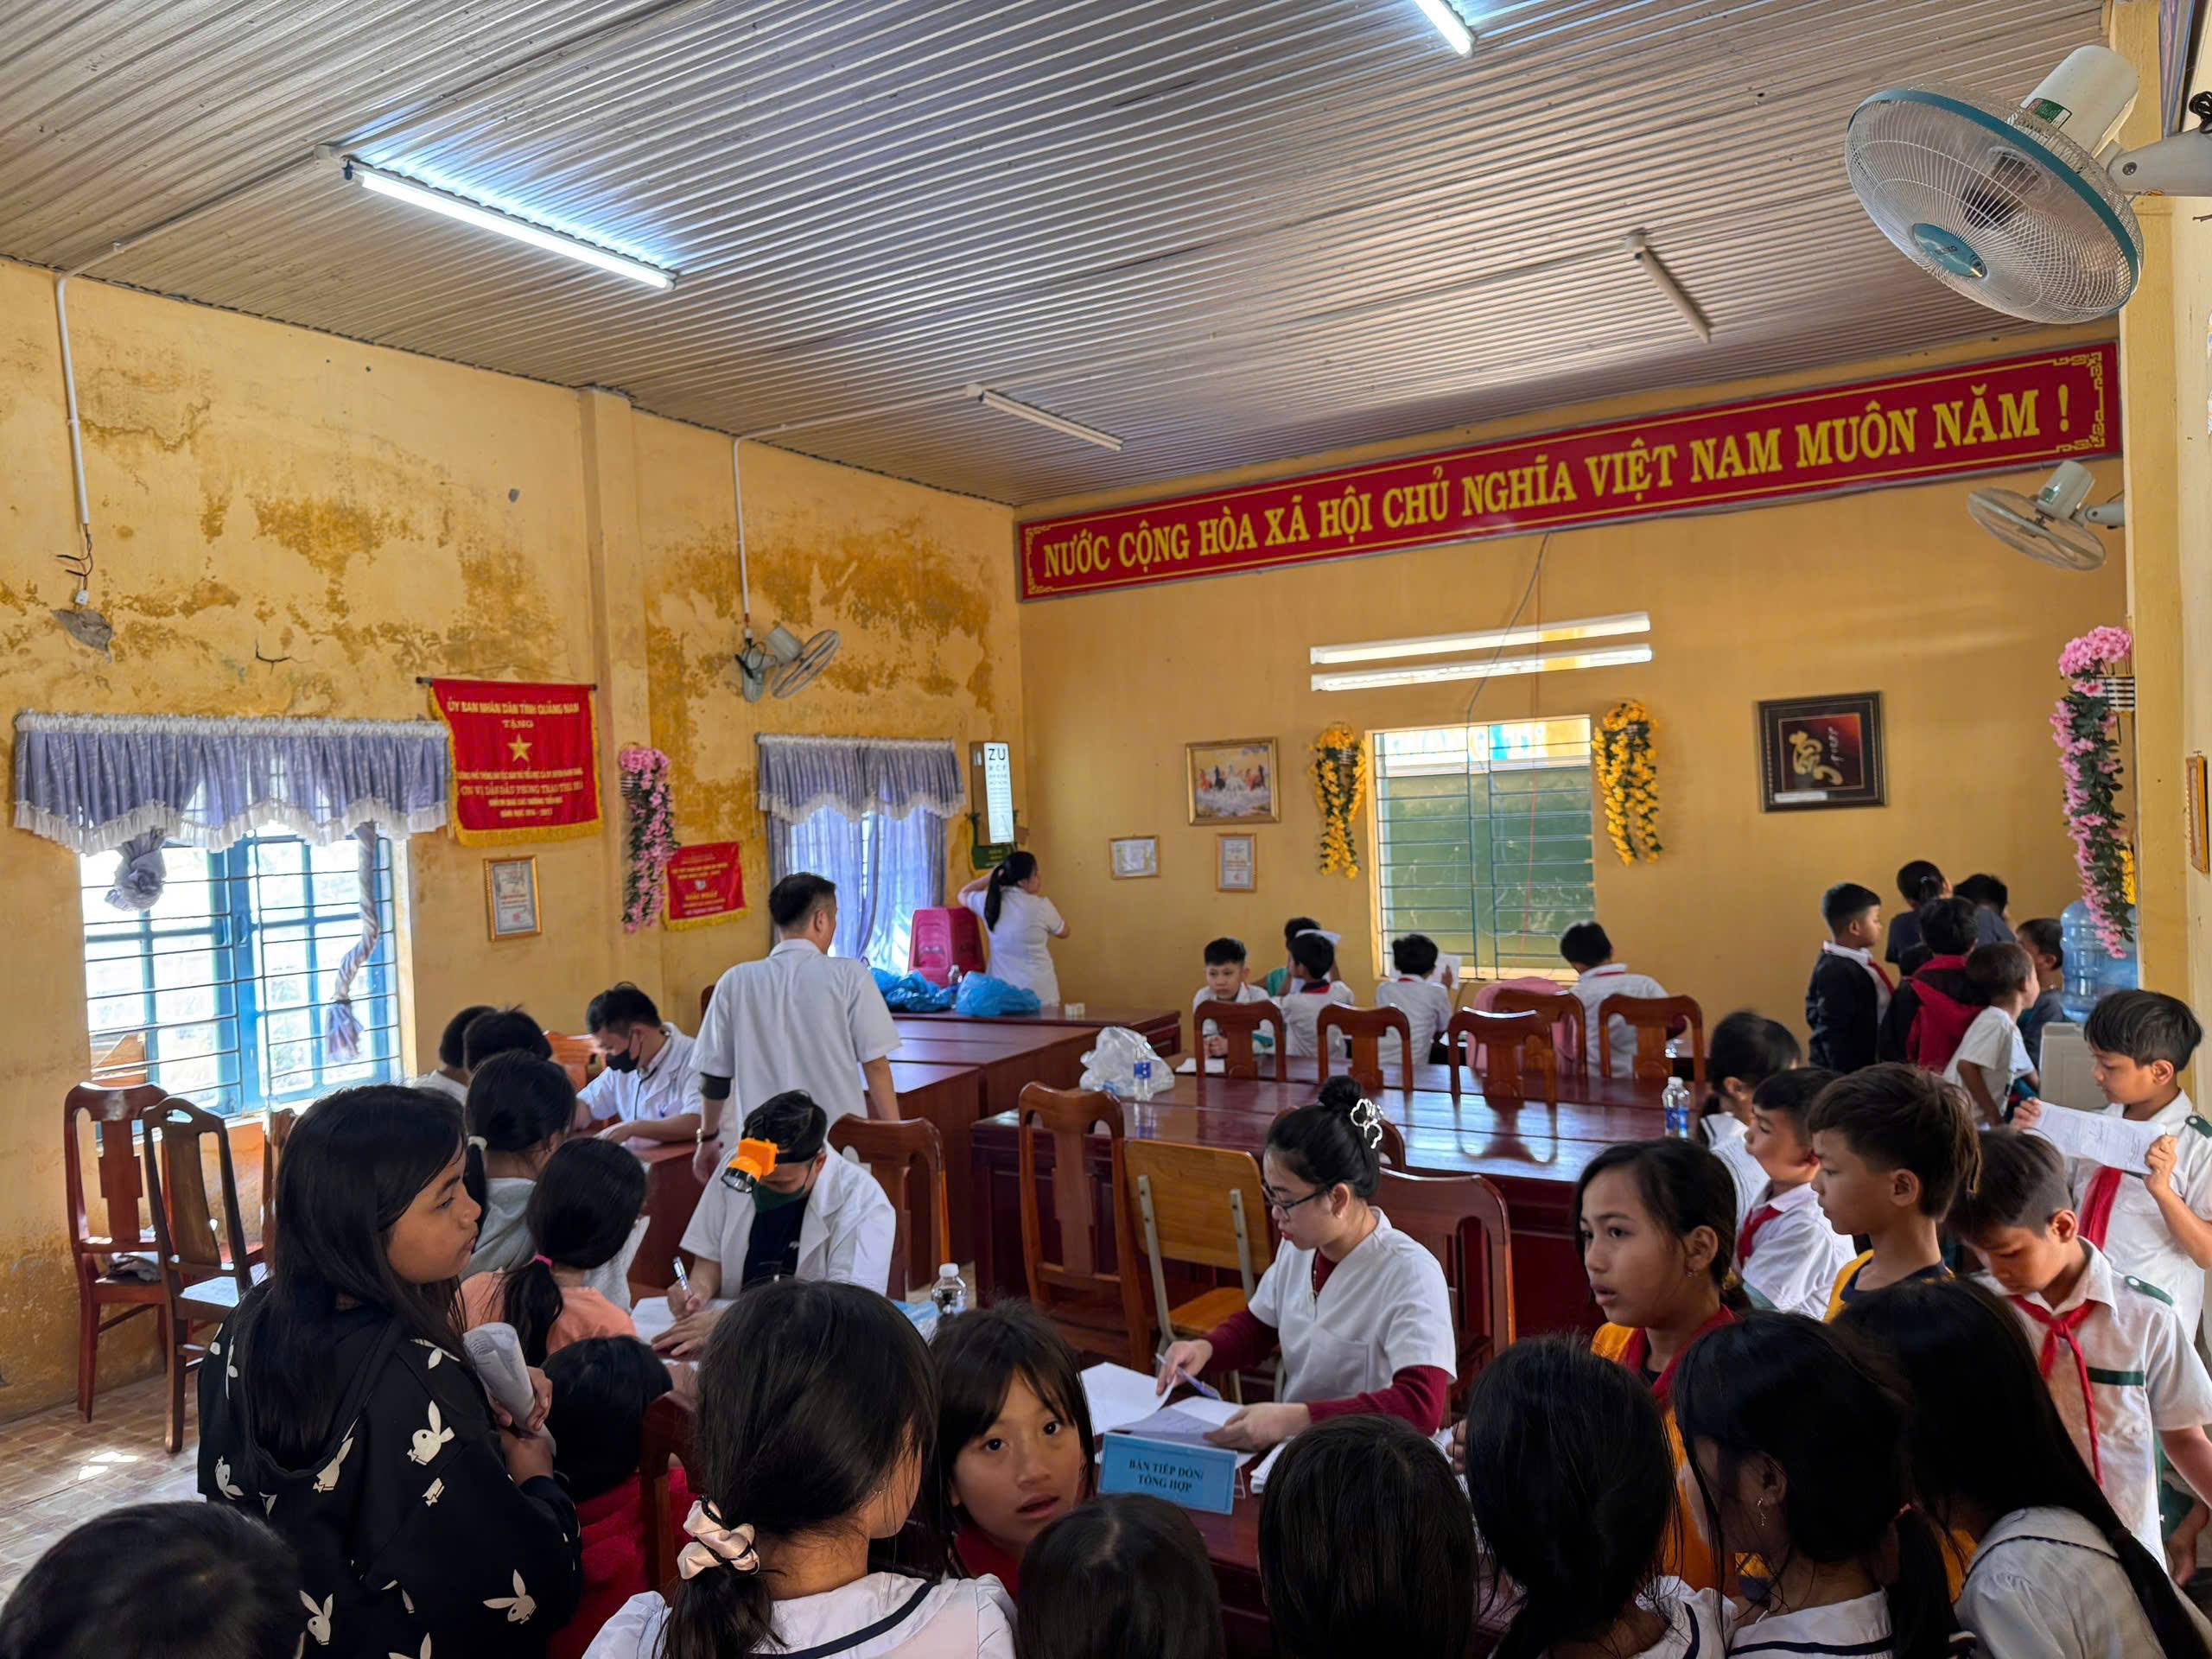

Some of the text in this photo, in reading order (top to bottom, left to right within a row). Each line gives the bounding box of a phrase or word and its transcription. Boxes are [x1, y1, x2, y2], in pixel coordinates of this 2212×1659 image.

[1043, 384, 2069, 578] NƯỚC CỘNG HÒA XÃ HỘI CHỦ NGHĨA VIỆT NAM MUÔN NĂM !
